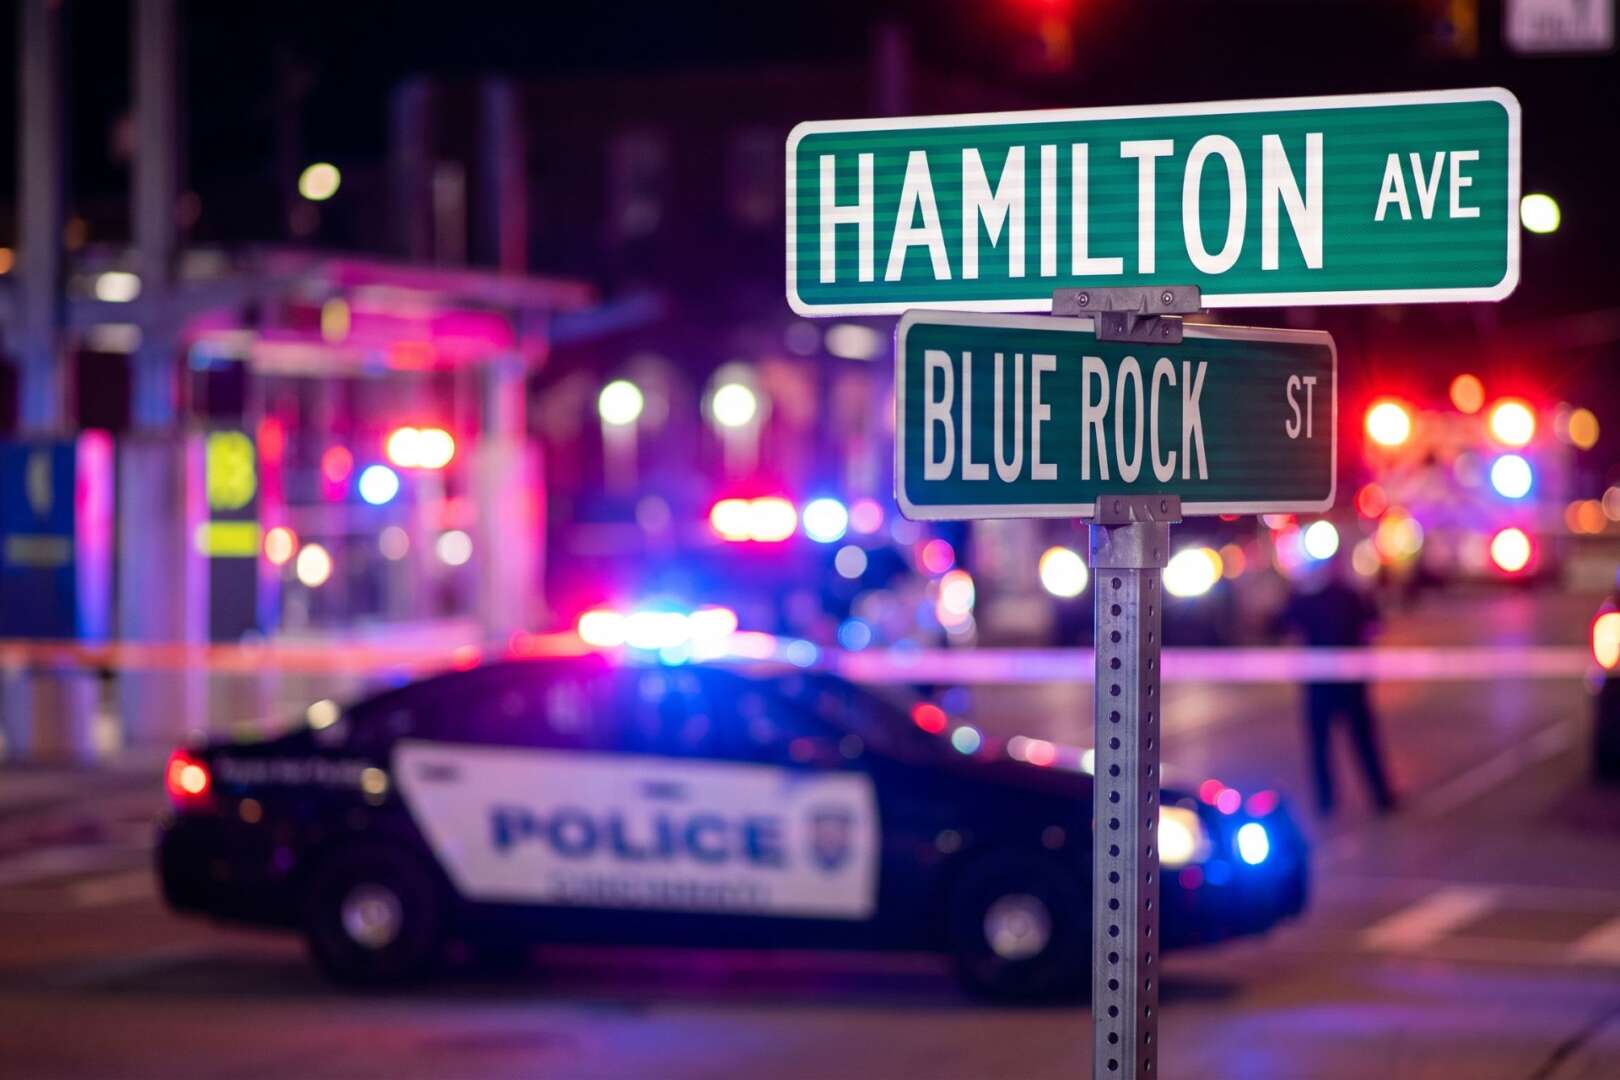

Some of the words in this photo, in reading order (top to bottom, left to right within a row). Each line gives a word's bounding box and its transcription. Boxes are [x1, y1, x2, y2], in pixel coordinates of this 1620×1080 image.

[818, 132, 1324, 284] HAMILTON
[1374, 149, 1481, 222] AVE
[923, 349, 1059, 482] BLUE
[1080, 356, 1210, 484] ROCK
[1285, 374, 1317, 439] ST
[489, 804, 786, 868] POLICE
